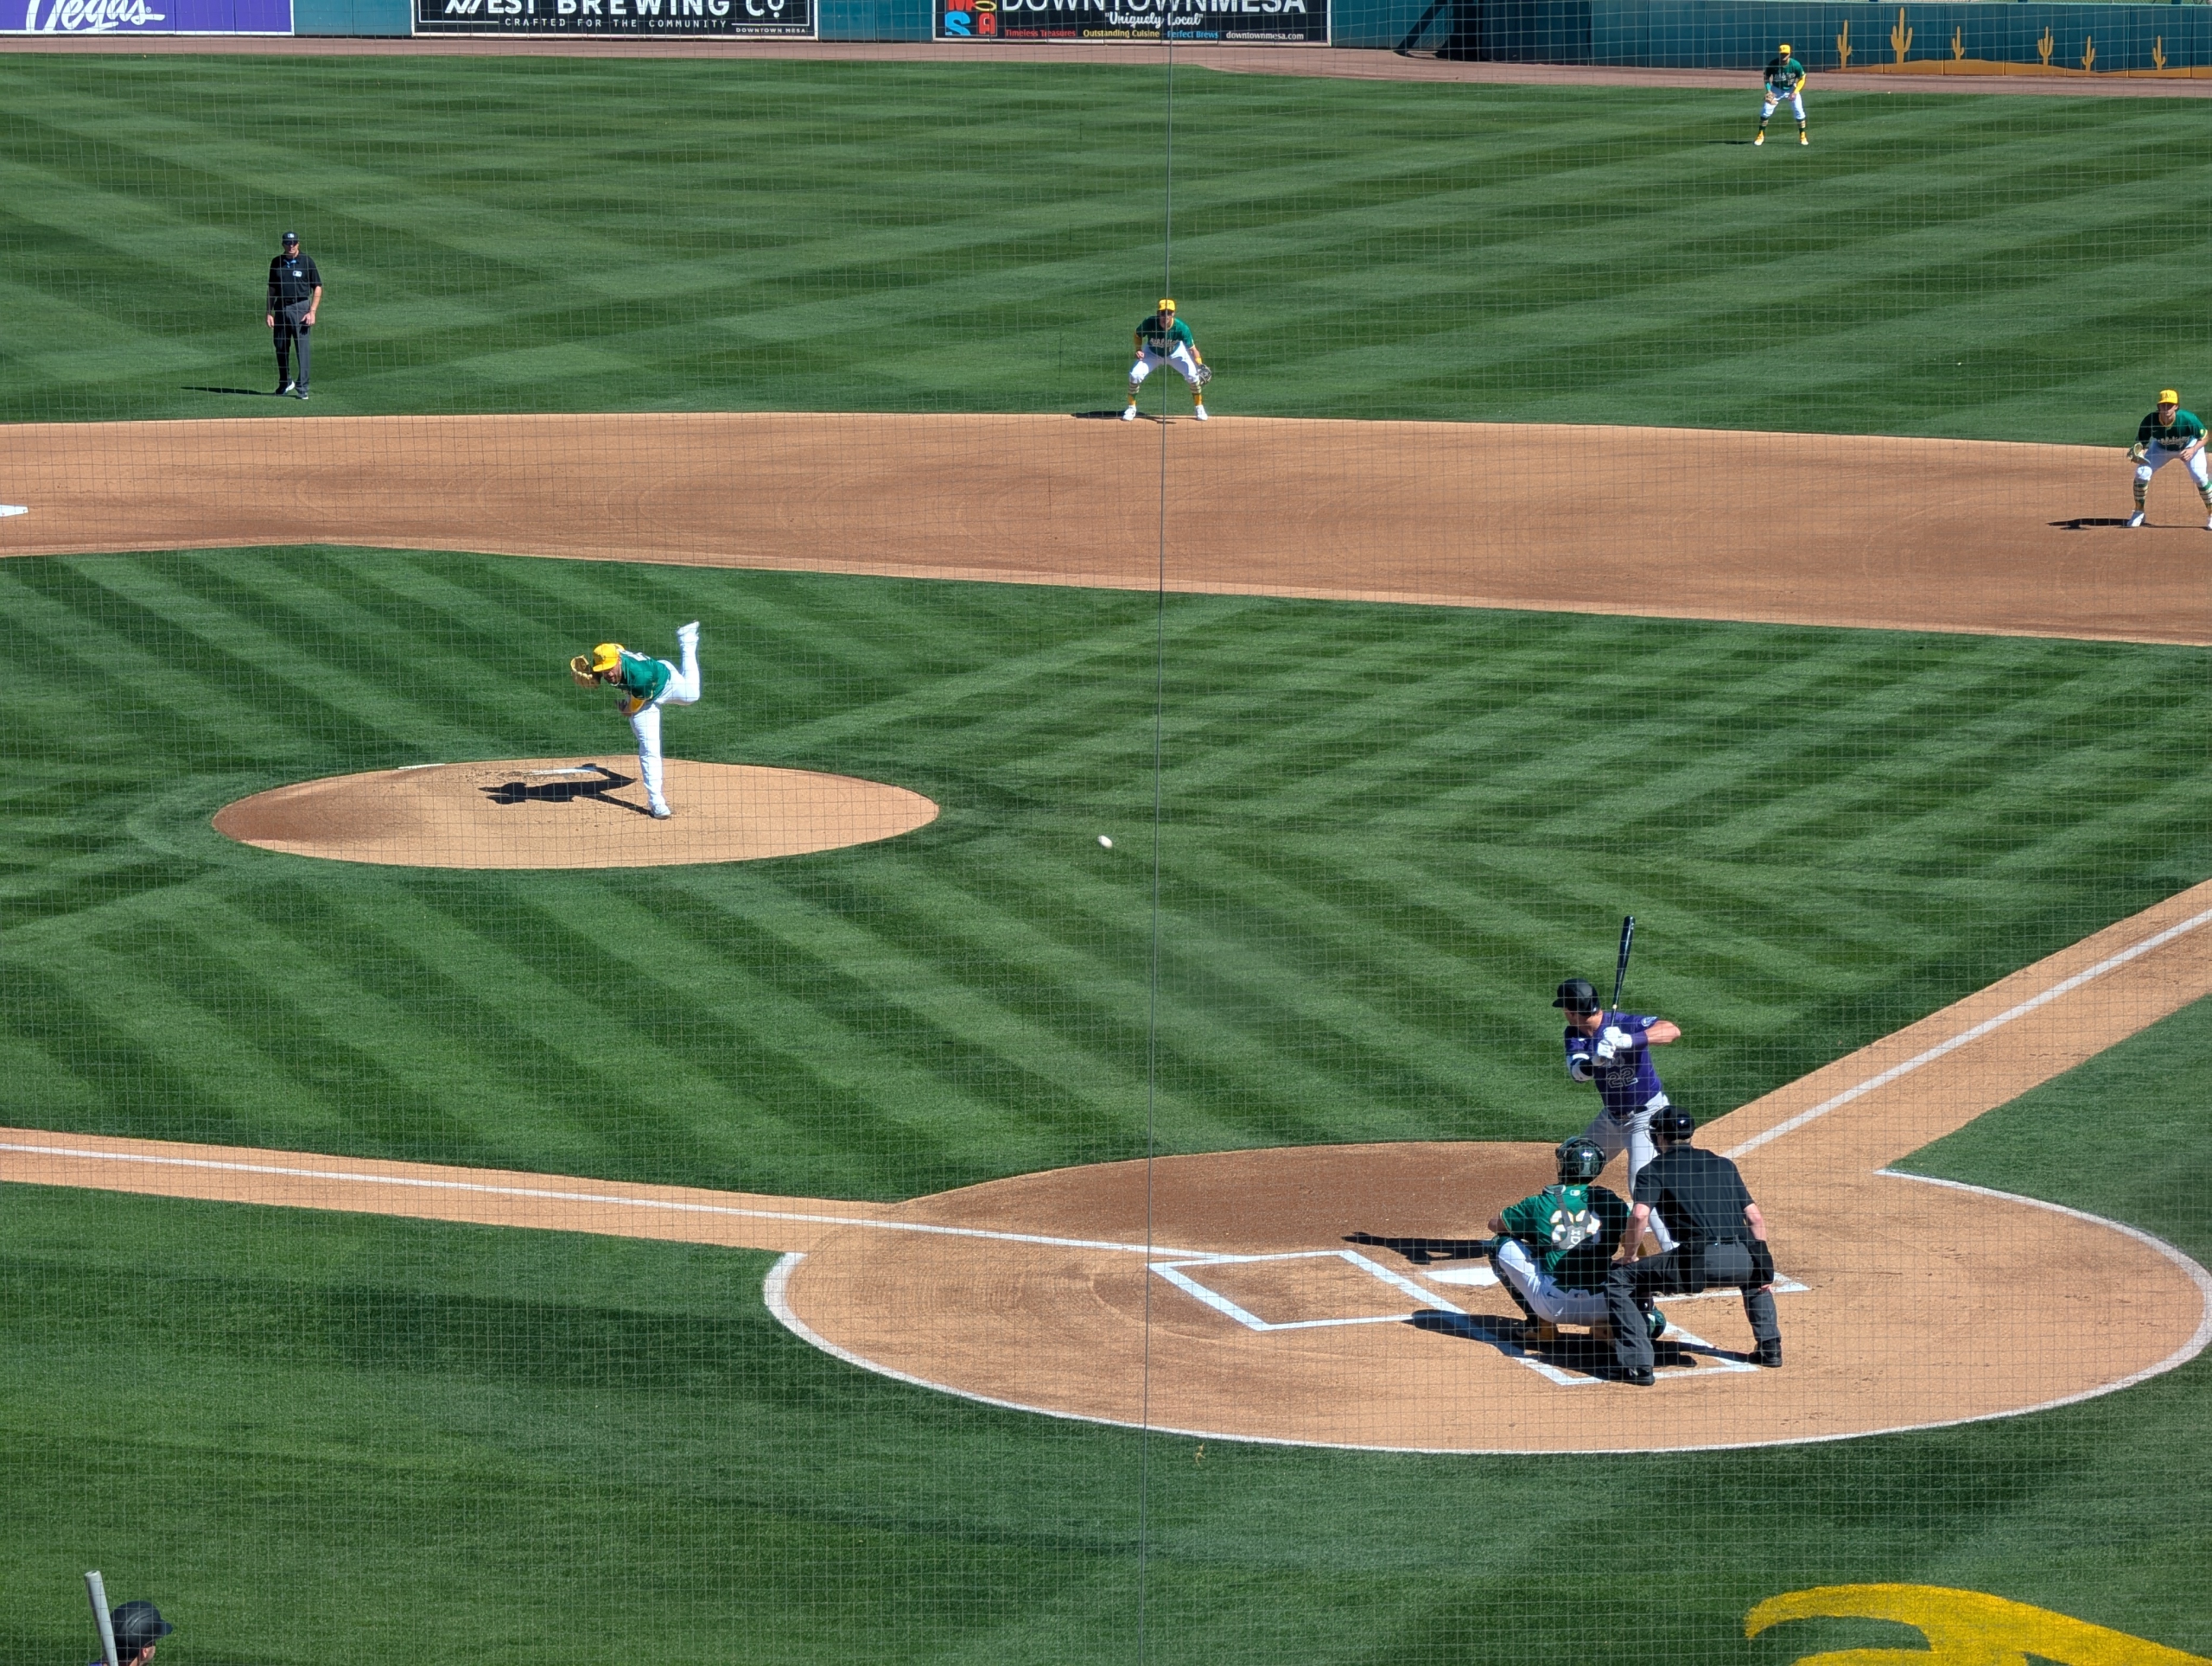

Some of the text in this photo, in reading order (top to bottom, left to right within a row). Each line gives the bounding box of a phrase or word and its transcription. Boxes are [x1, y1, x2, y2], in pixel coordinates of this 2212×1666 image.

[557, 0, 730, 16] BREWING
[505, 18, 727, 29] CRAFTED FOR THE COMMUNITY
[1083, 29, 1130, 39] Outstanding
[1167, 30, 1219, 39] Perfect Brews
[1226, 31, 1305, 41] downtownmesa.com
[1606, 1067, 1639, 1088] 22
